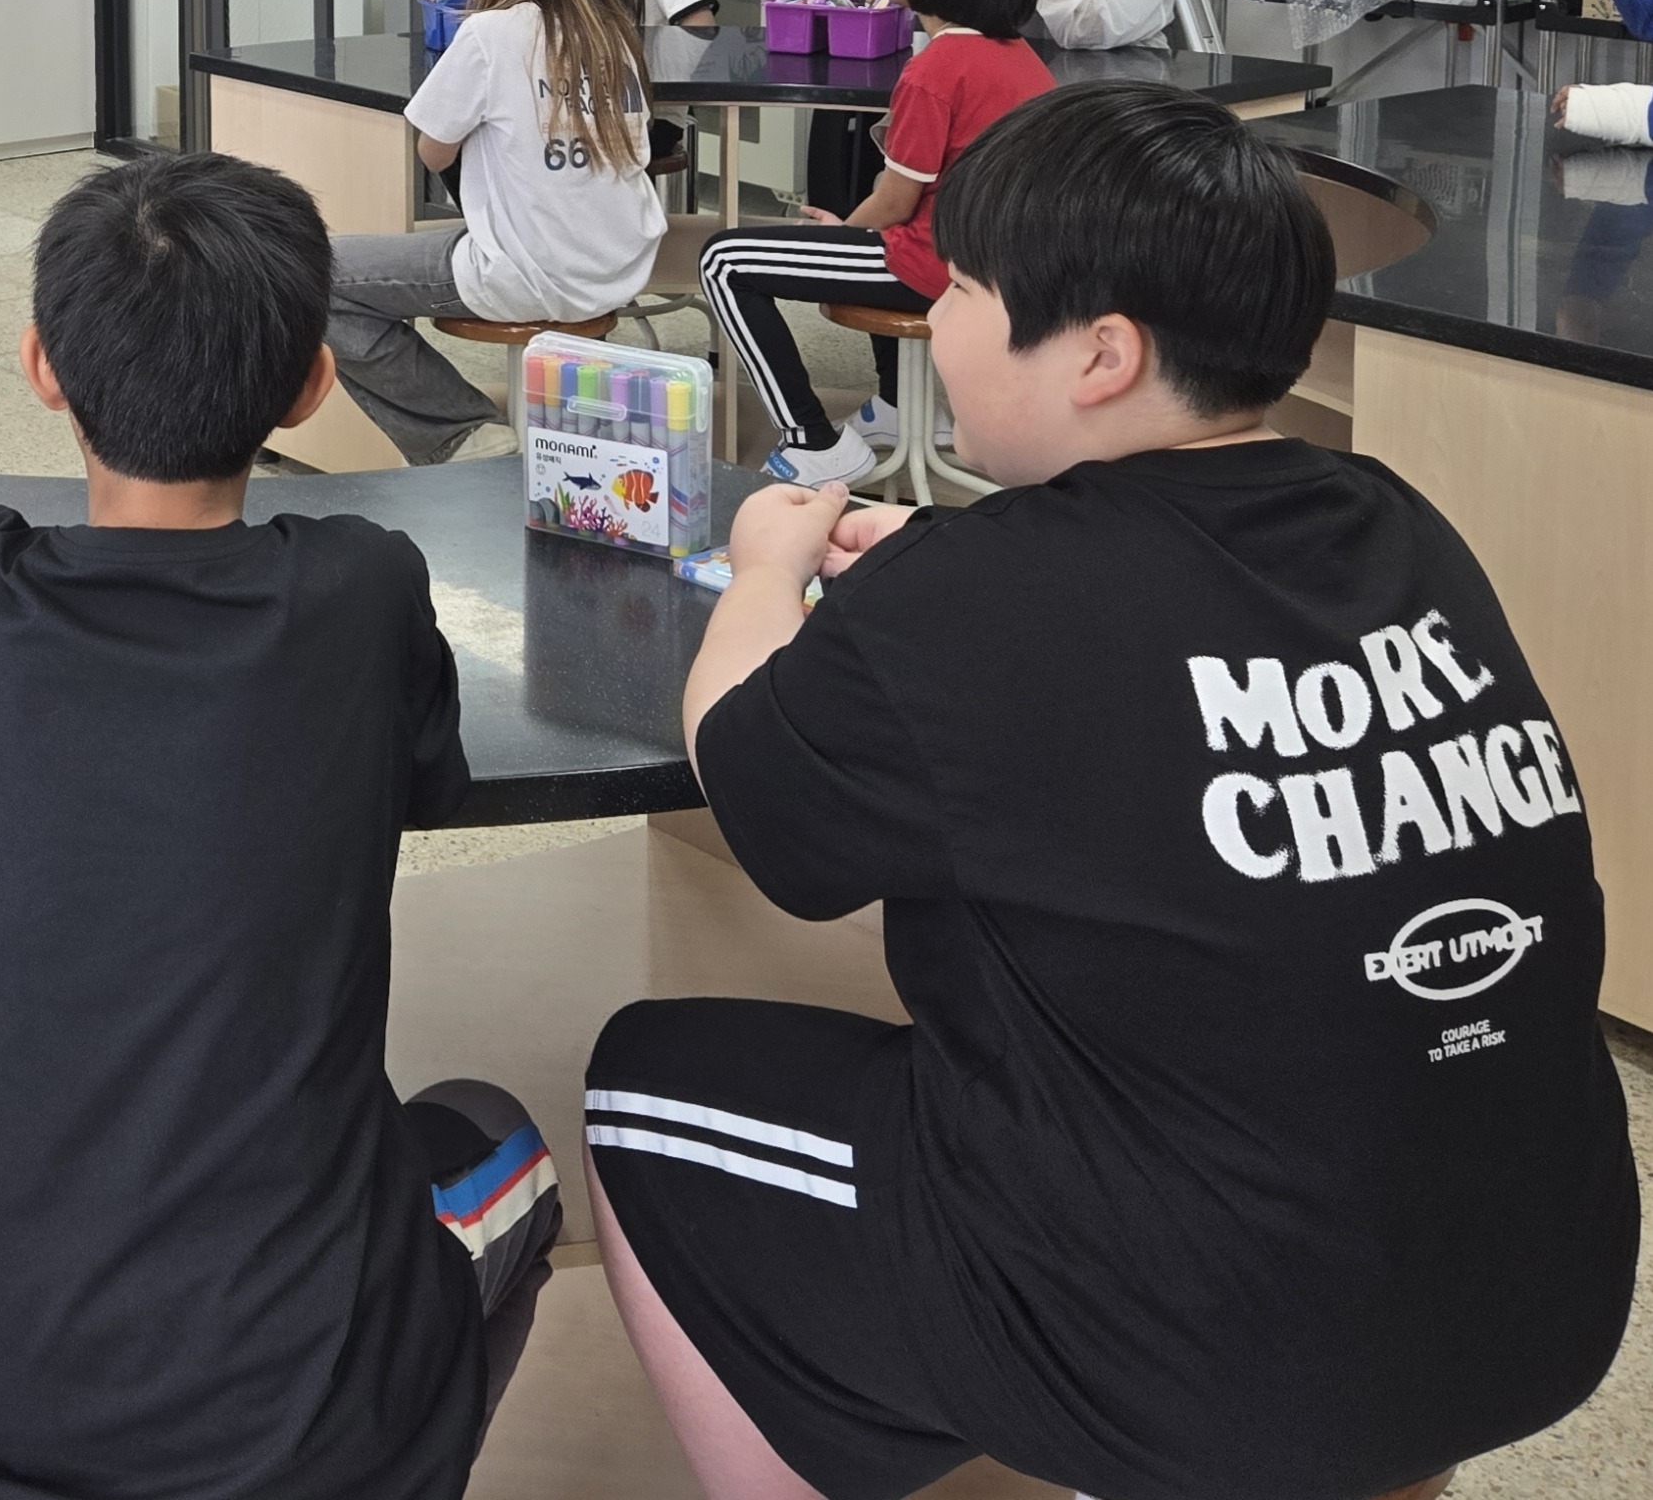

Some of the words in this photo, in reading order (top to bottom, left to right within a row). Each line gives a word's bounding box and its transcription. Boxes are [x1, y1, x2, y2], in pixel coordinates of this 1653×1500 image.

[544, 137, 591, 171] 66
[641, 520, 661, 537] 24
[1187, 609, 1495, 758] MORE
[1202, 720, 1582, 883] CHANGE
[1449, 915, 1544, 962] UTMOST
[1428, 1049, 1443, 1063] TO
[1443, 1039, 1471, 1057] TAKE
[1471, 1037, 1481, 1050] A
[1481, 1030, 1507, 1047] RISK
[1441, 1019, 1491, 1044] COURAGE
